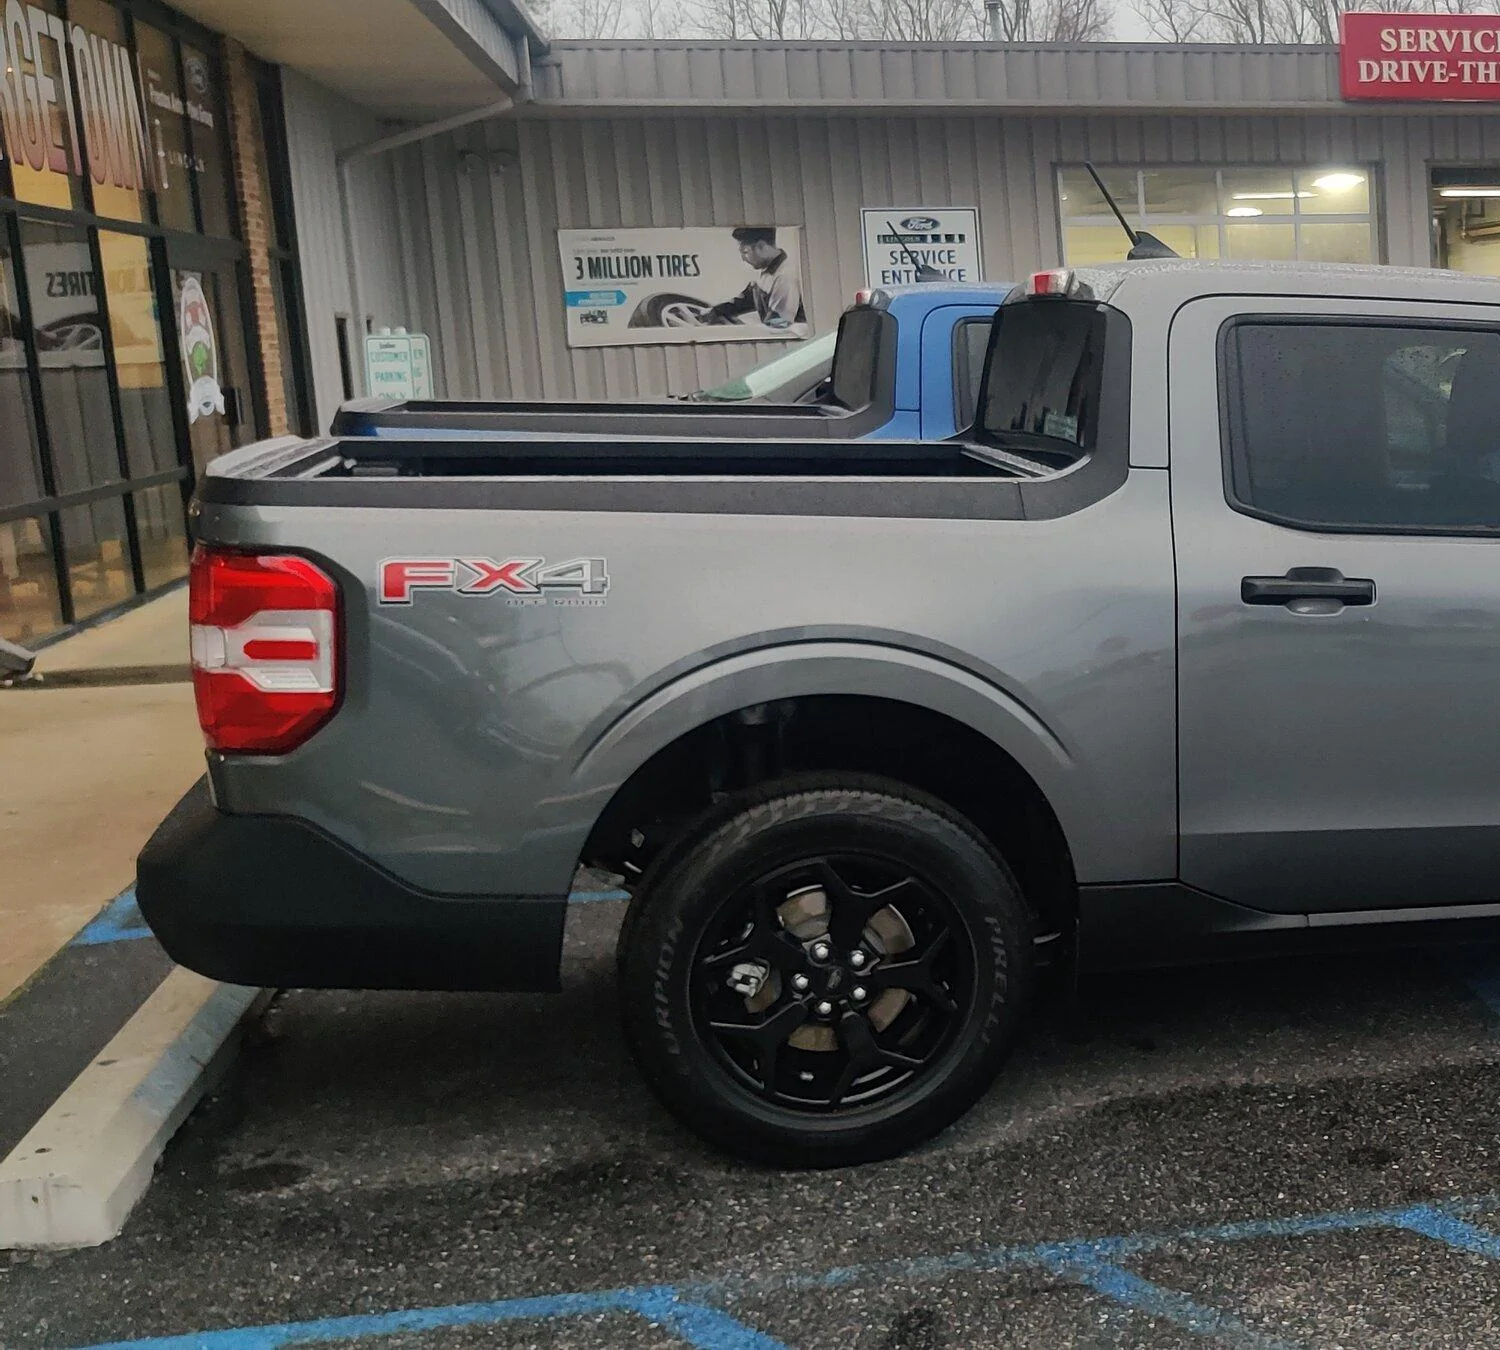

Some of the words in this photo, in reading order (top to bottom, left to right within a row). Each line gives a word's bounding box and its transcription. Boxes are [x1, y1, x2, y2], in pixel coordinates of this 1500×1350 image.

[907, 218, 934, 230] Ford
[574, 256, 584, 280] 3
[587, 255, 653, 280] MILLION
[656, 254, 701, 277] TIRES
[889, 249, 957, 265] SERVICE
[881, 268, 967, 285] ENTCE
[379, 557, 609, 606] FX4
[984, 915, 1008, 1046] PIRELLI
